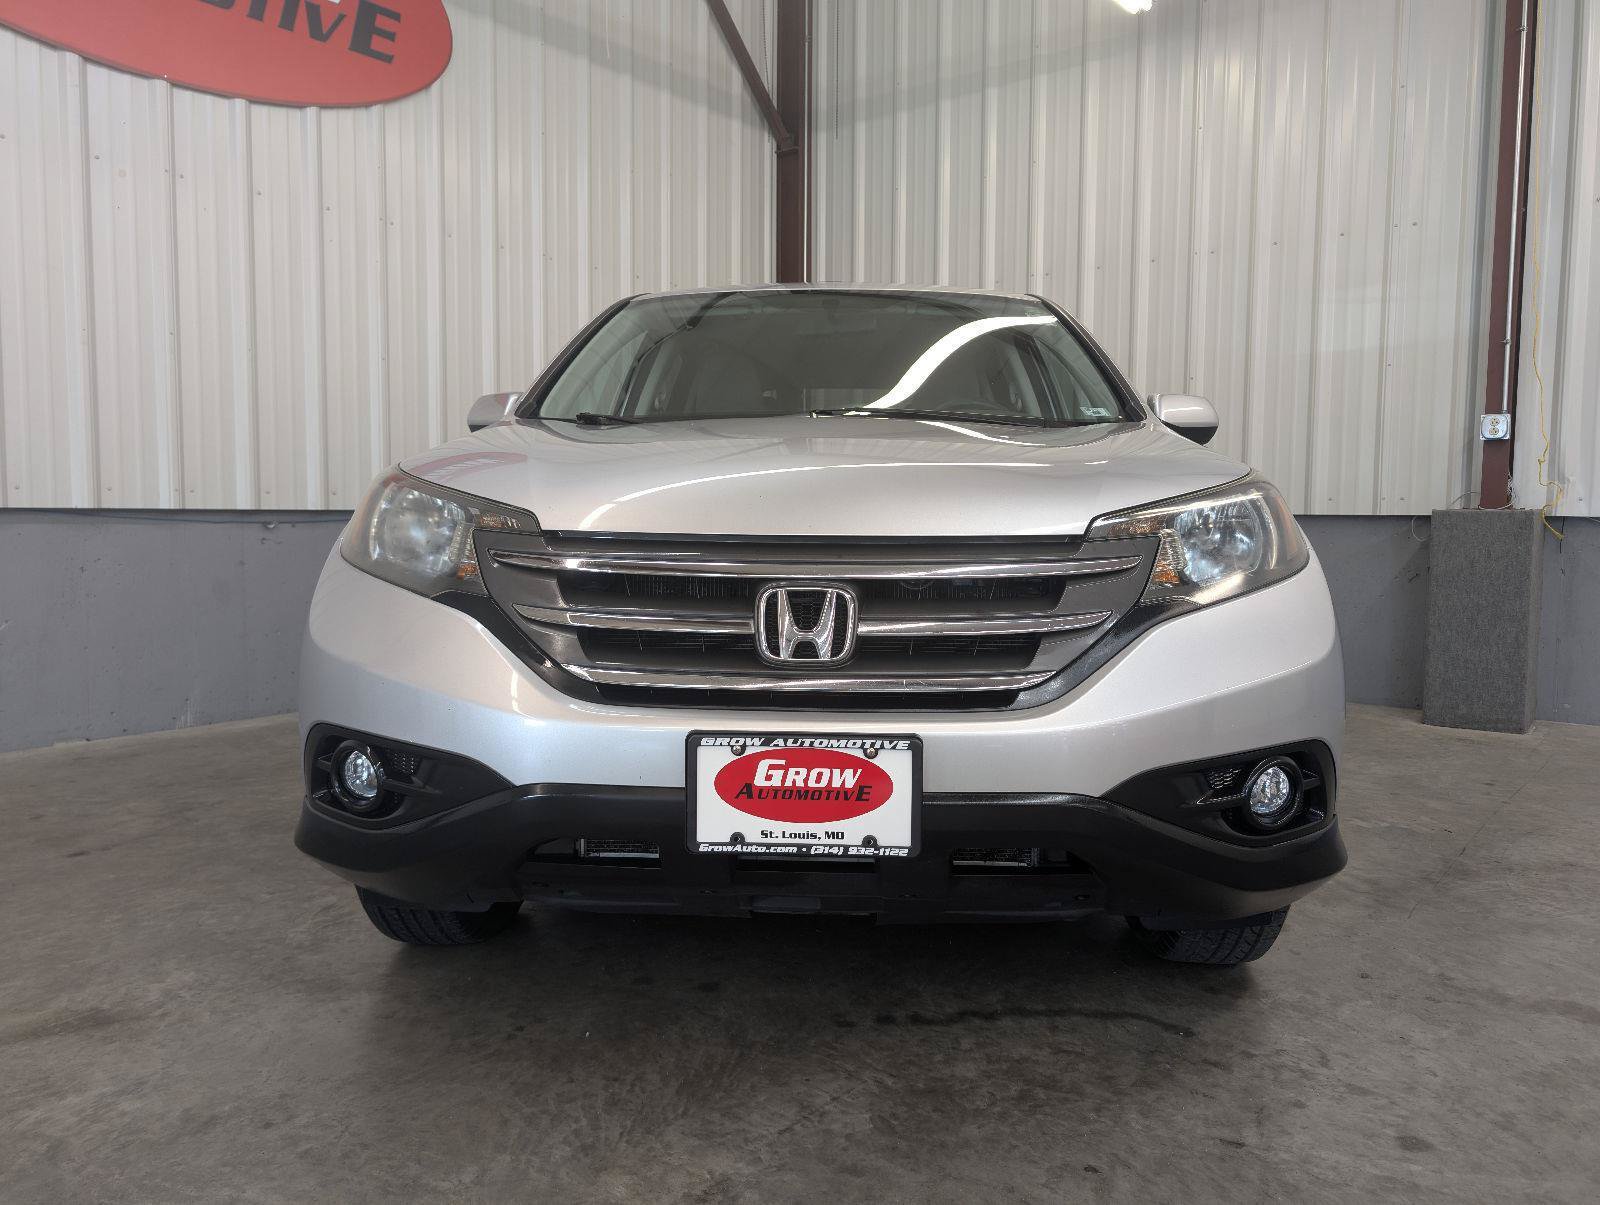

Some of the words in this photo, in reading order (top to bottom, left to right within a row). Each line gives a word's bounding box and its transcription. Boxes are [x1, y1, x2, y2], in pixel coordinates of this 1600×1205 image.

[195, 0, 402, 64] IVE
[700, 737, 765, 746] GROW
[769, 738, 910, 750] AUTOMOTIVE
[753, 758, 863, 789] GROW
[734, 783, 873, 802] AUTOMOTIVE
[760, 829, 779, 839] St.
[781, 830, 821, 841] Louis,
[824, 831, 845, 840] MO
[699, 843, 798, 854] GrowAuto.com
[810, 845, 844, 855] (314)
[847, 846, 909, 857] 932-1122
